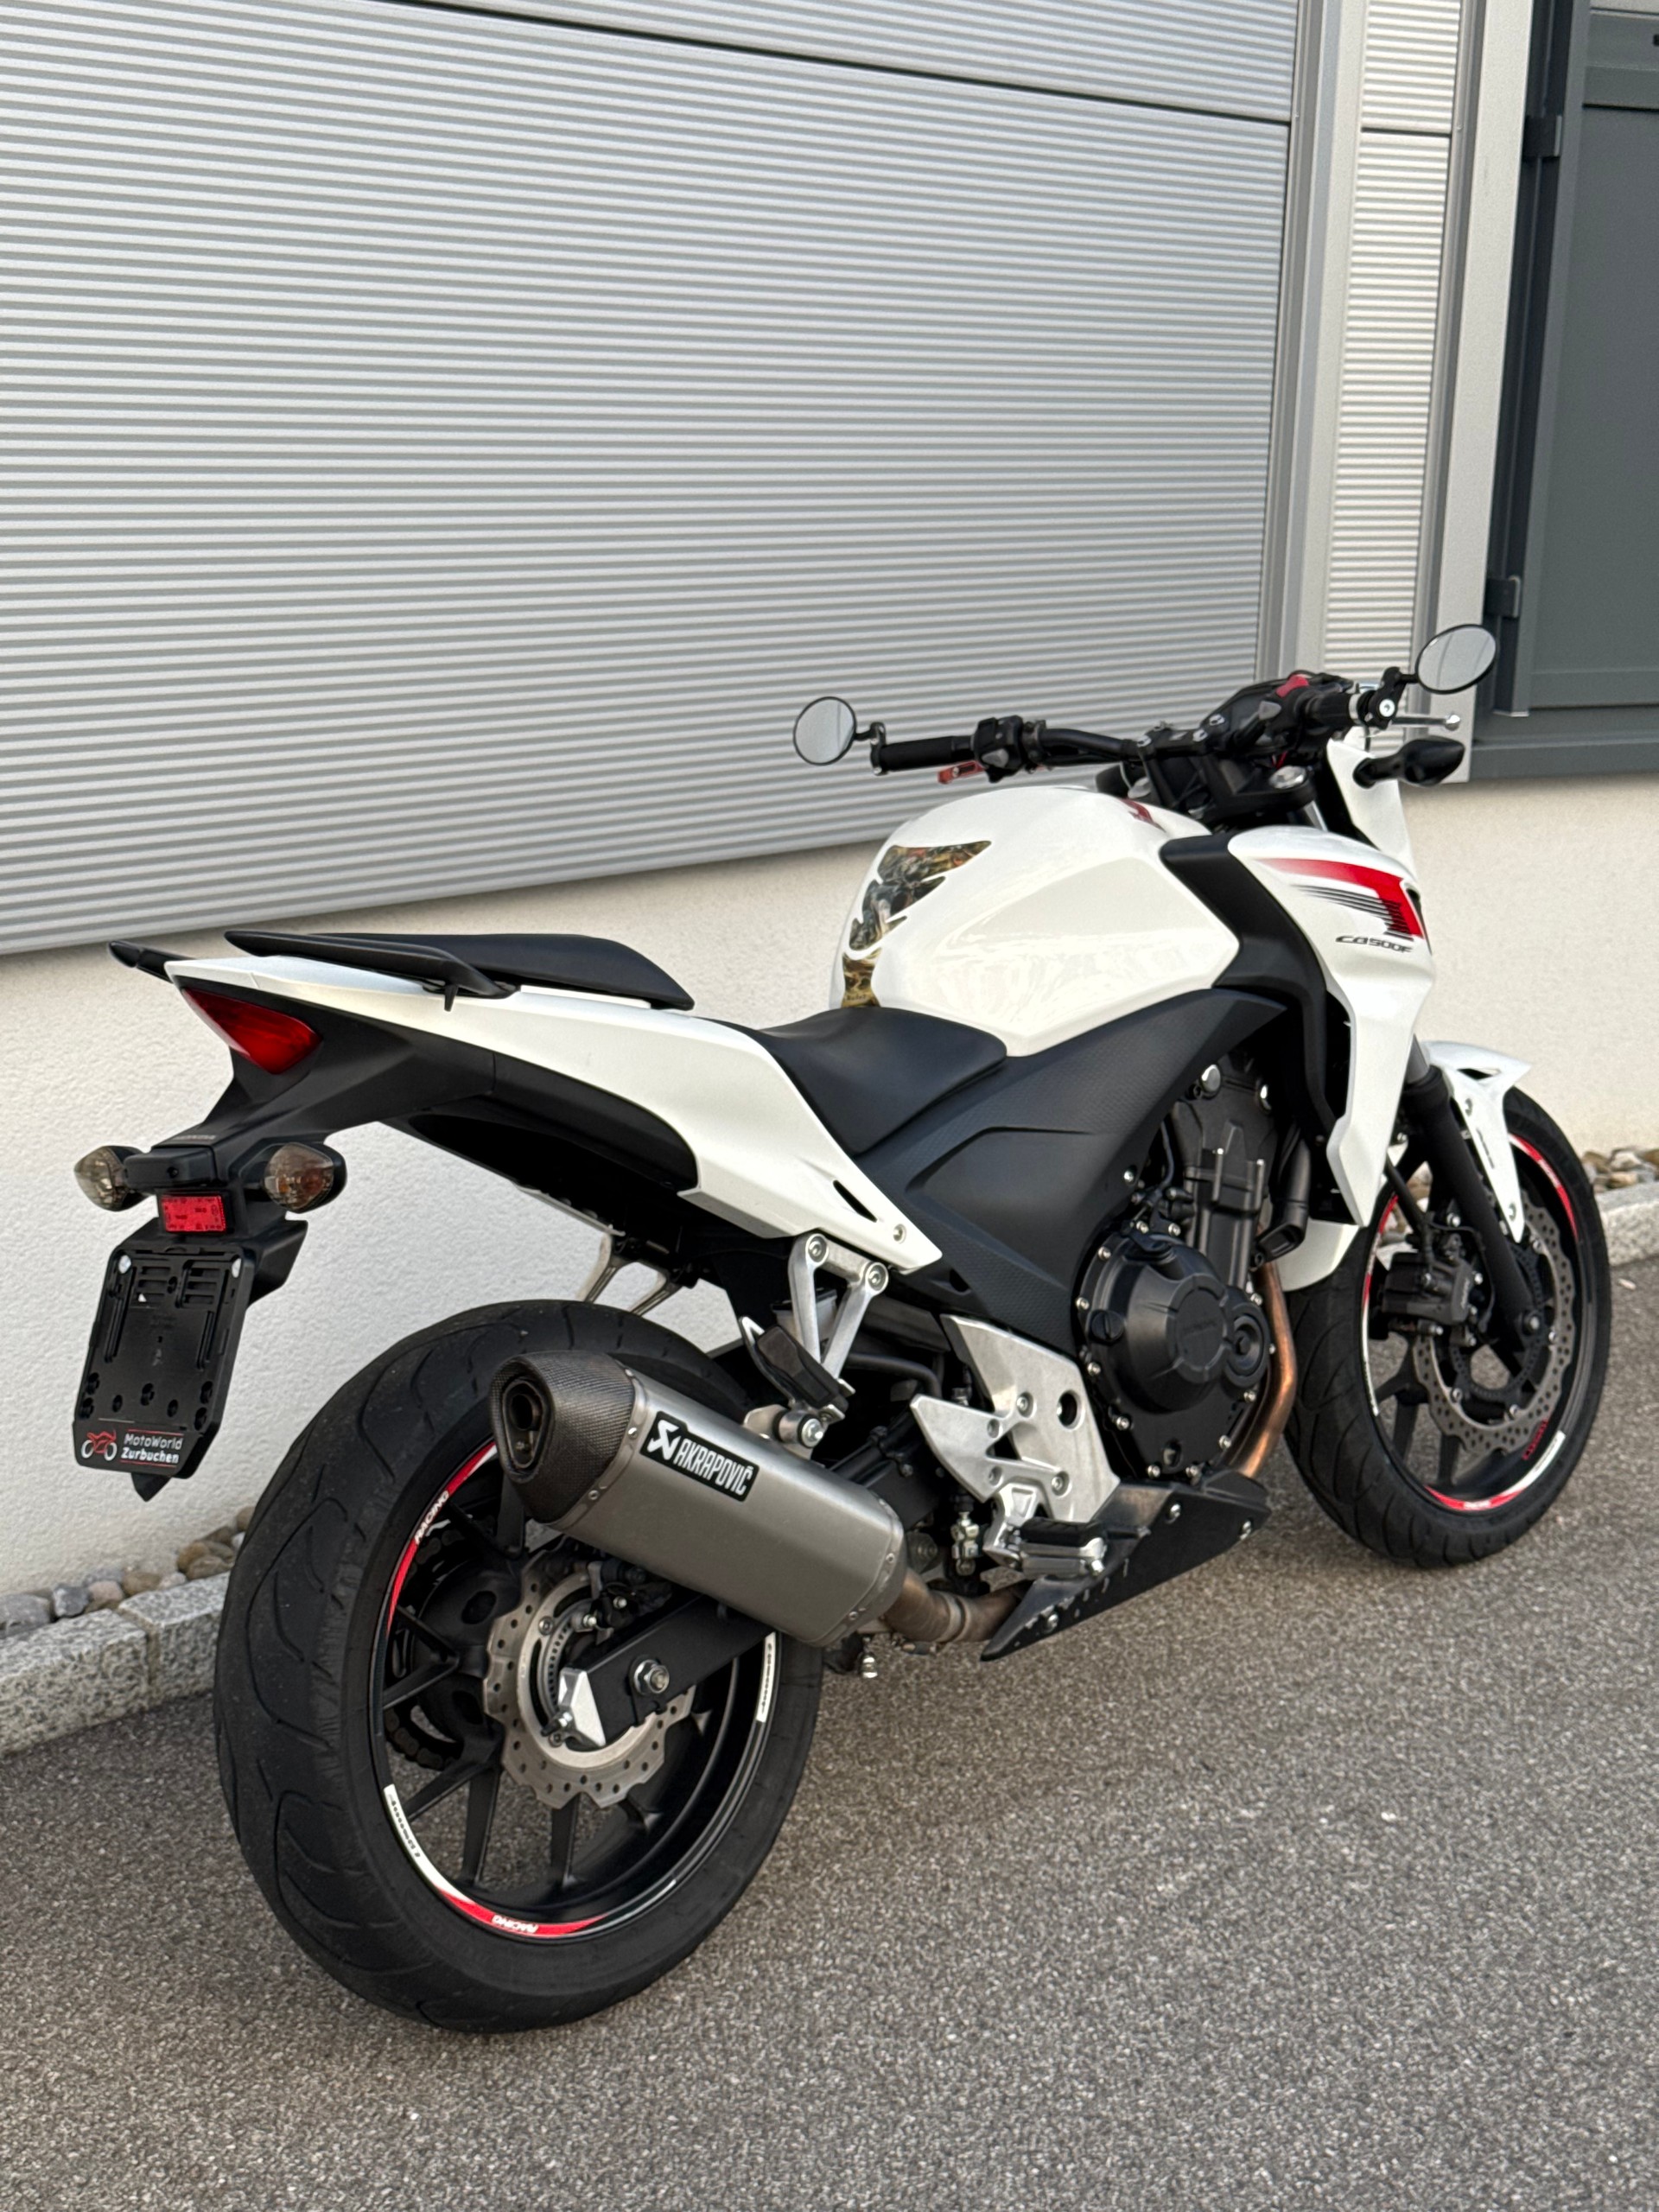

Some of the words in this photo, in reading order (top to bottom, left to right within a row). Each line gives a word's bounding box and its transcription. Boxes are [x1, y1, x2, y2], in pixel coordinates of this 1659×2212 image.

[124, 1433, 183, 1450] MotoWorld
[121, 1447, 180, 1464] Zurbuchen
[673, 1438, 753, 1496] AKRAPOVIČ
[415, 1491, 449, 1545] RACING
[492, 1914, 539, 1934] RACING
